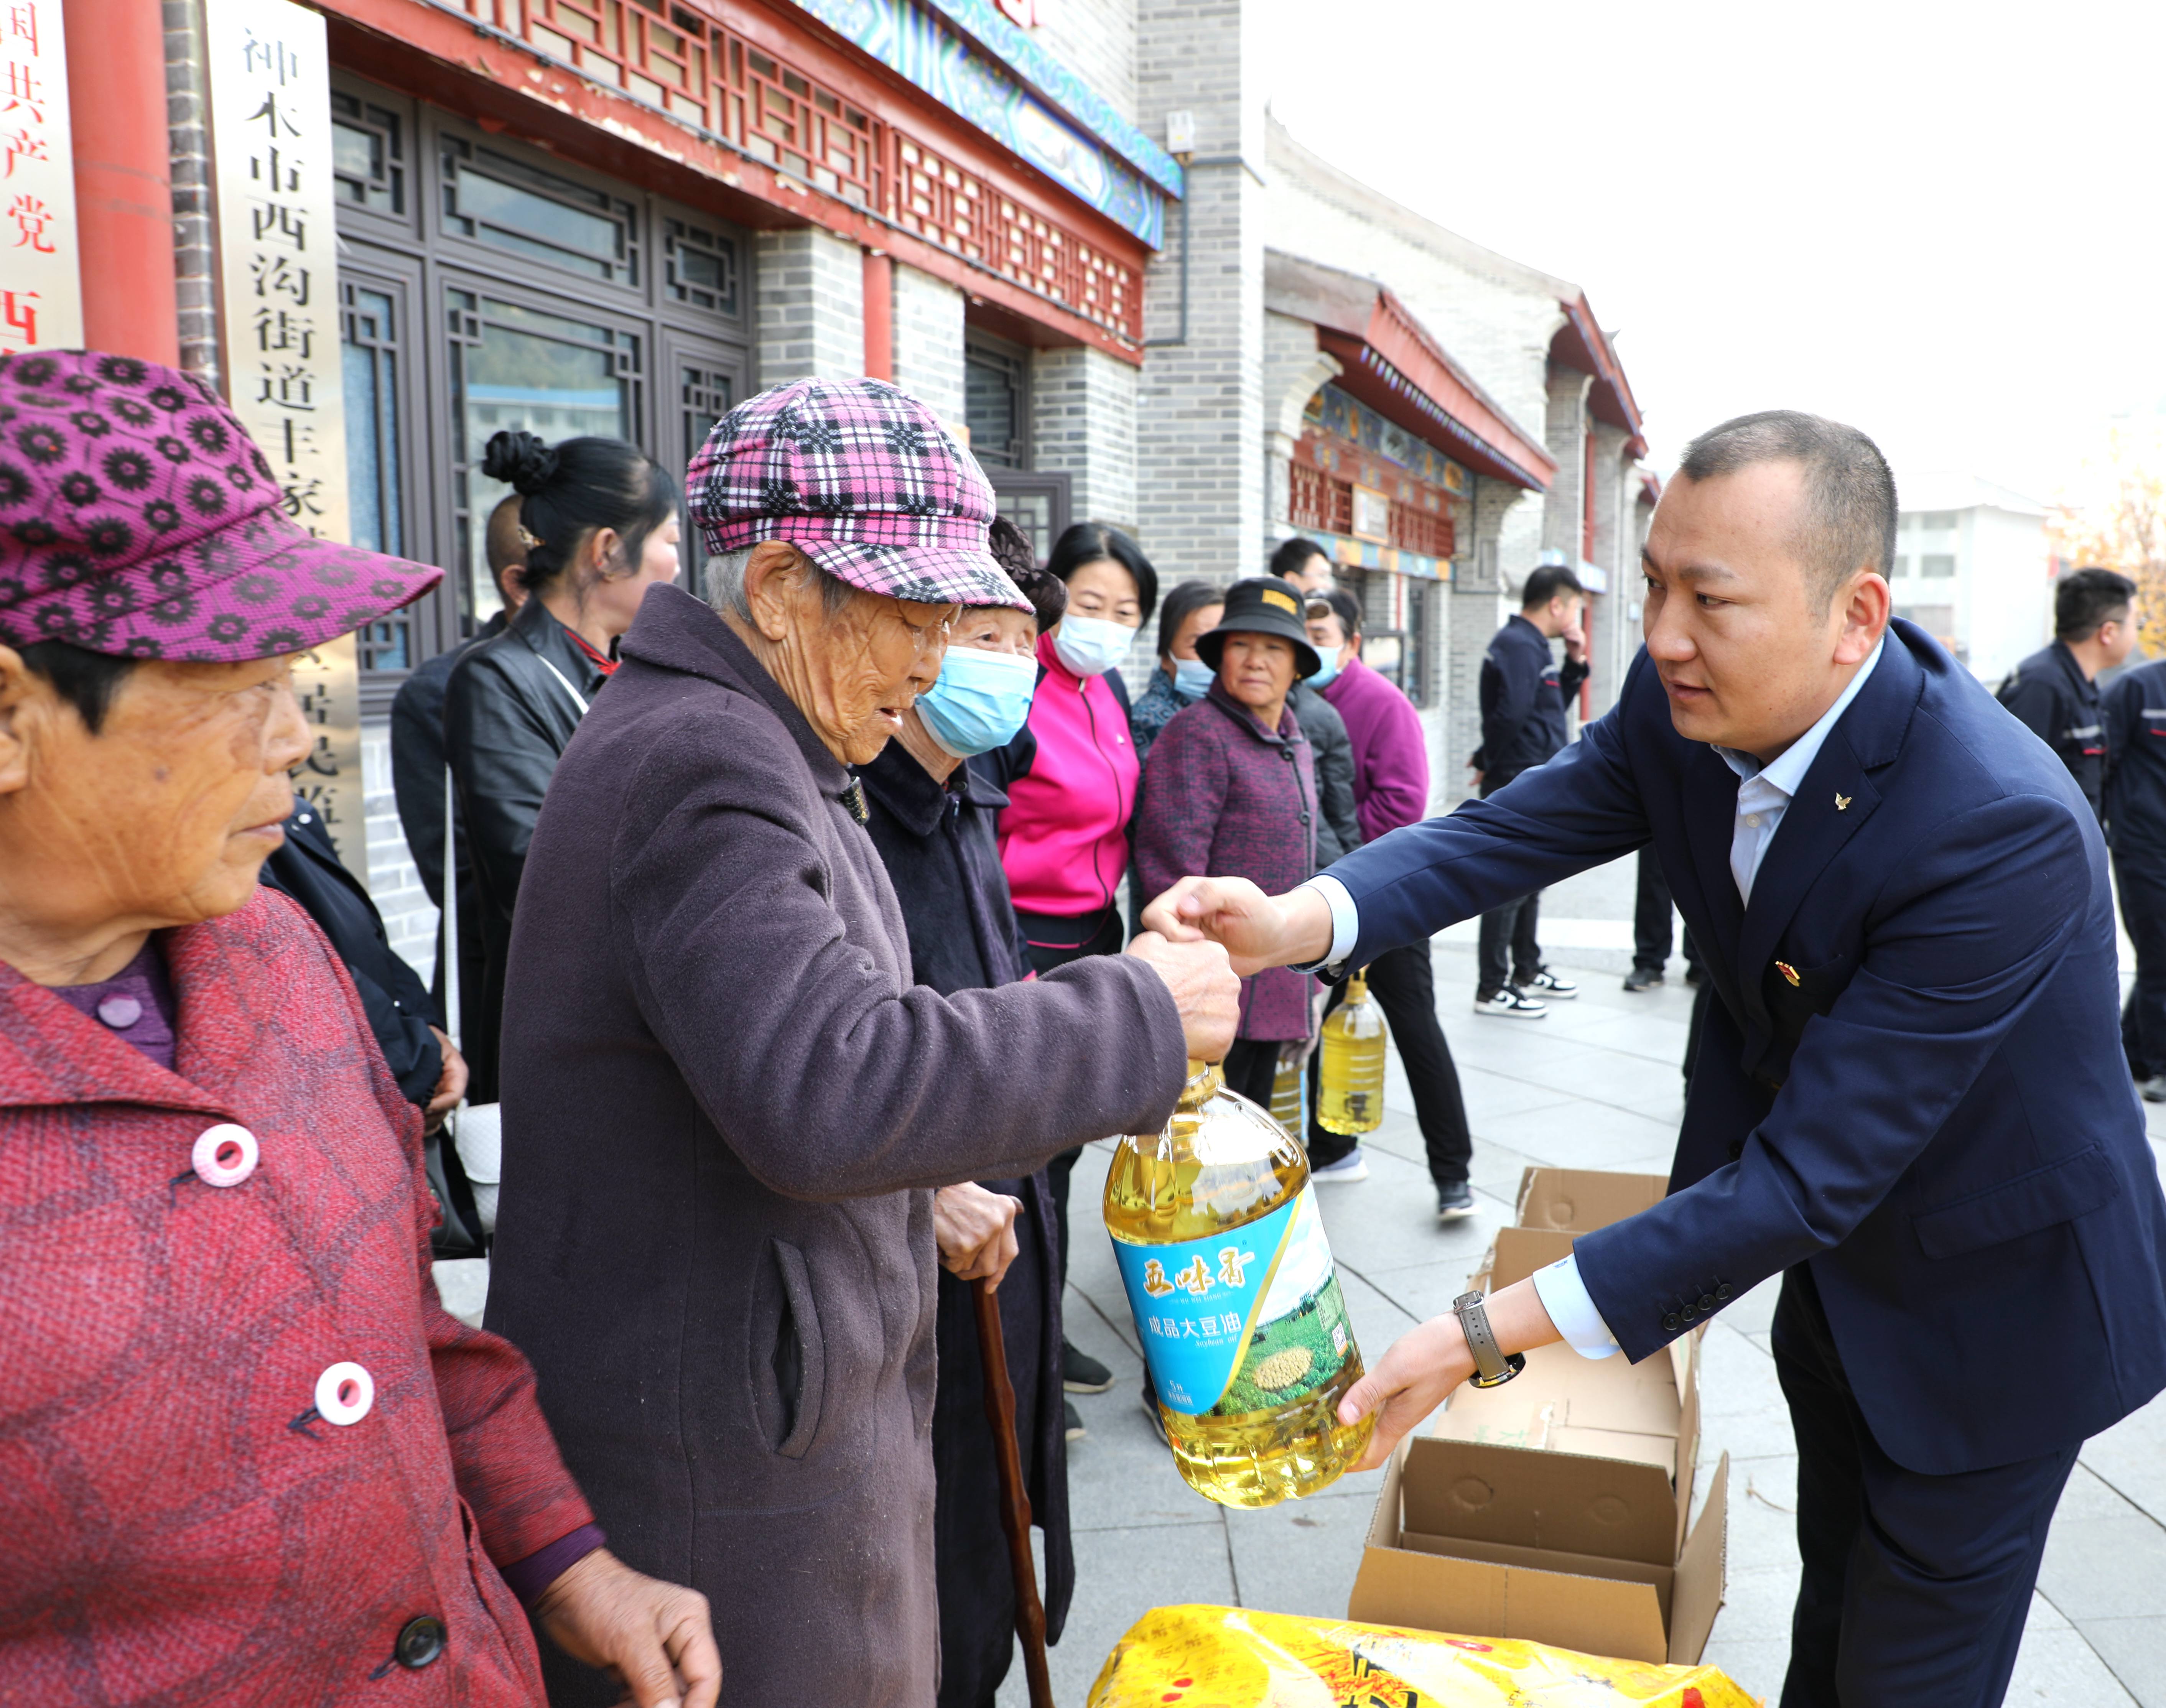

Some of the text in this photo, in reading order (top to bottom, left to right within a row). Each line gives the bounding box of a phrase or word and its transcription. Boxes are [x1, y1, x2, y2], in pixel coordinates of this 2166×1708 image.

[1143, 1246, 1255, 1299] 五味香
[1149, 1311, 1242, 1339] 成品大豆油
